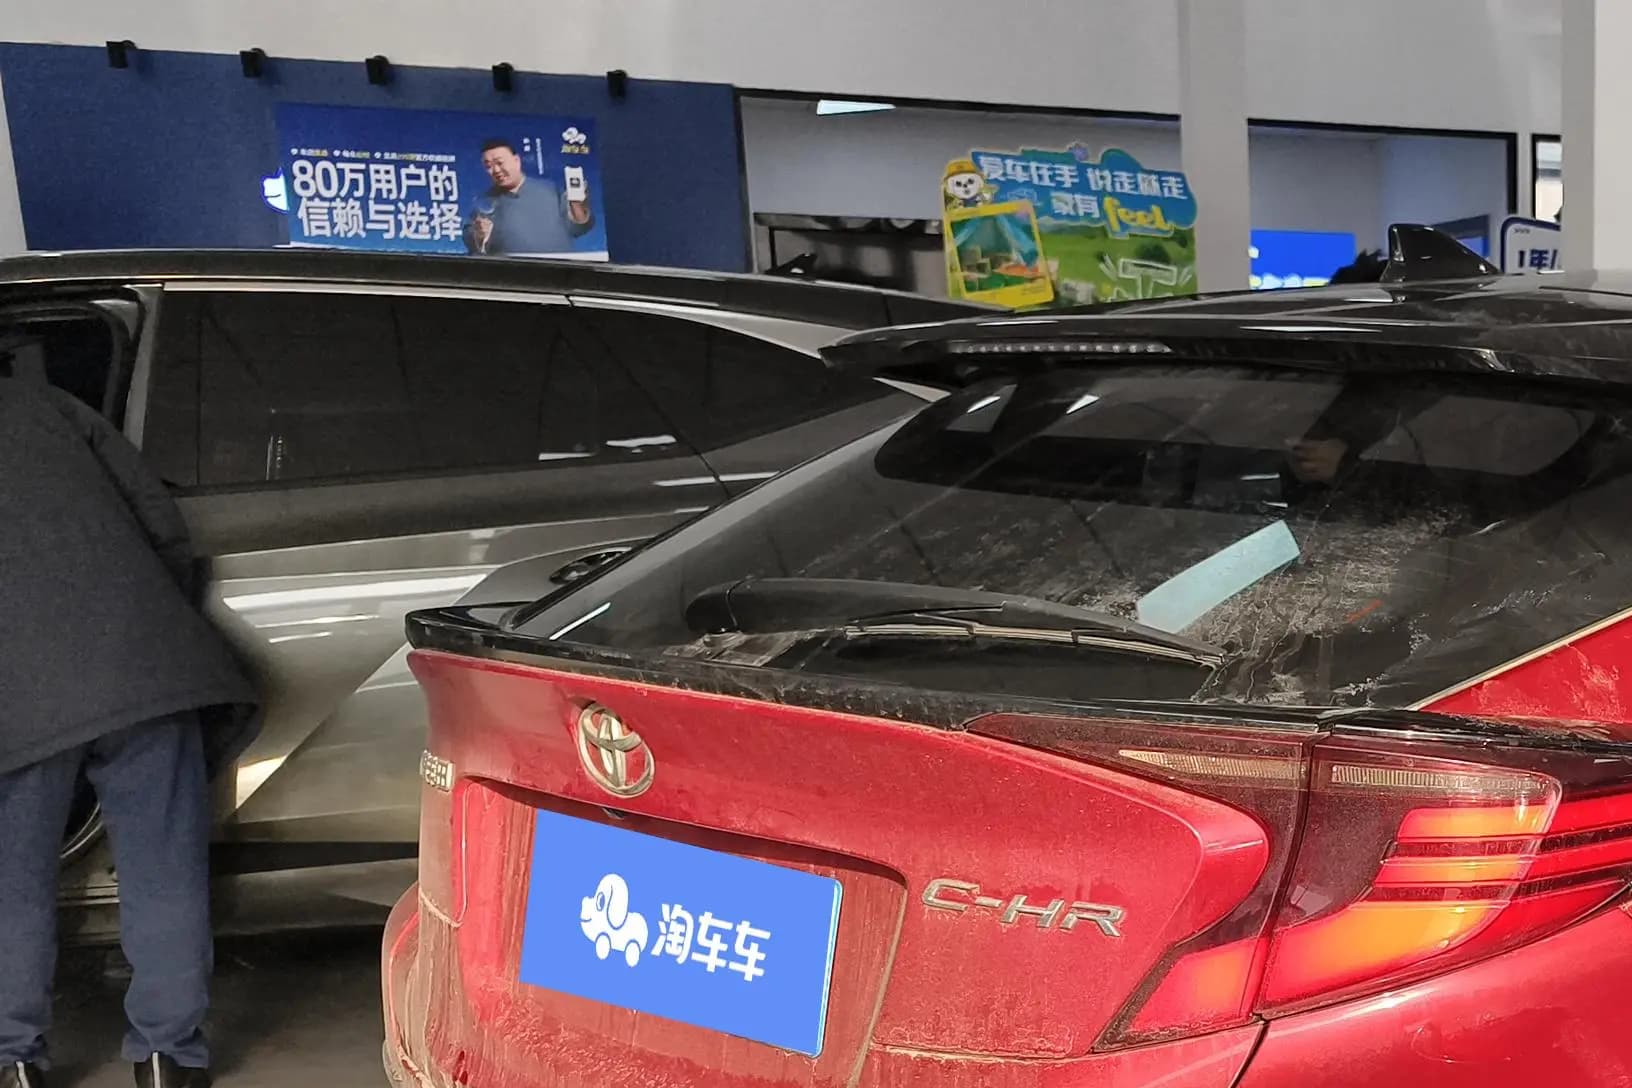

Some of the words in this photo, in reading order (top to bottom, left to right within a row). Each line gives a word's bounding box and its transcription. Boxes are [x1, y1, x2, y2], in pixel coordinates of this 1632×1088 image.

[292, 160, 459, 201] 80万用户的
[298, 197, 464, 241] 信赖与选择
[922, 878, 1124, 937] C-HR
